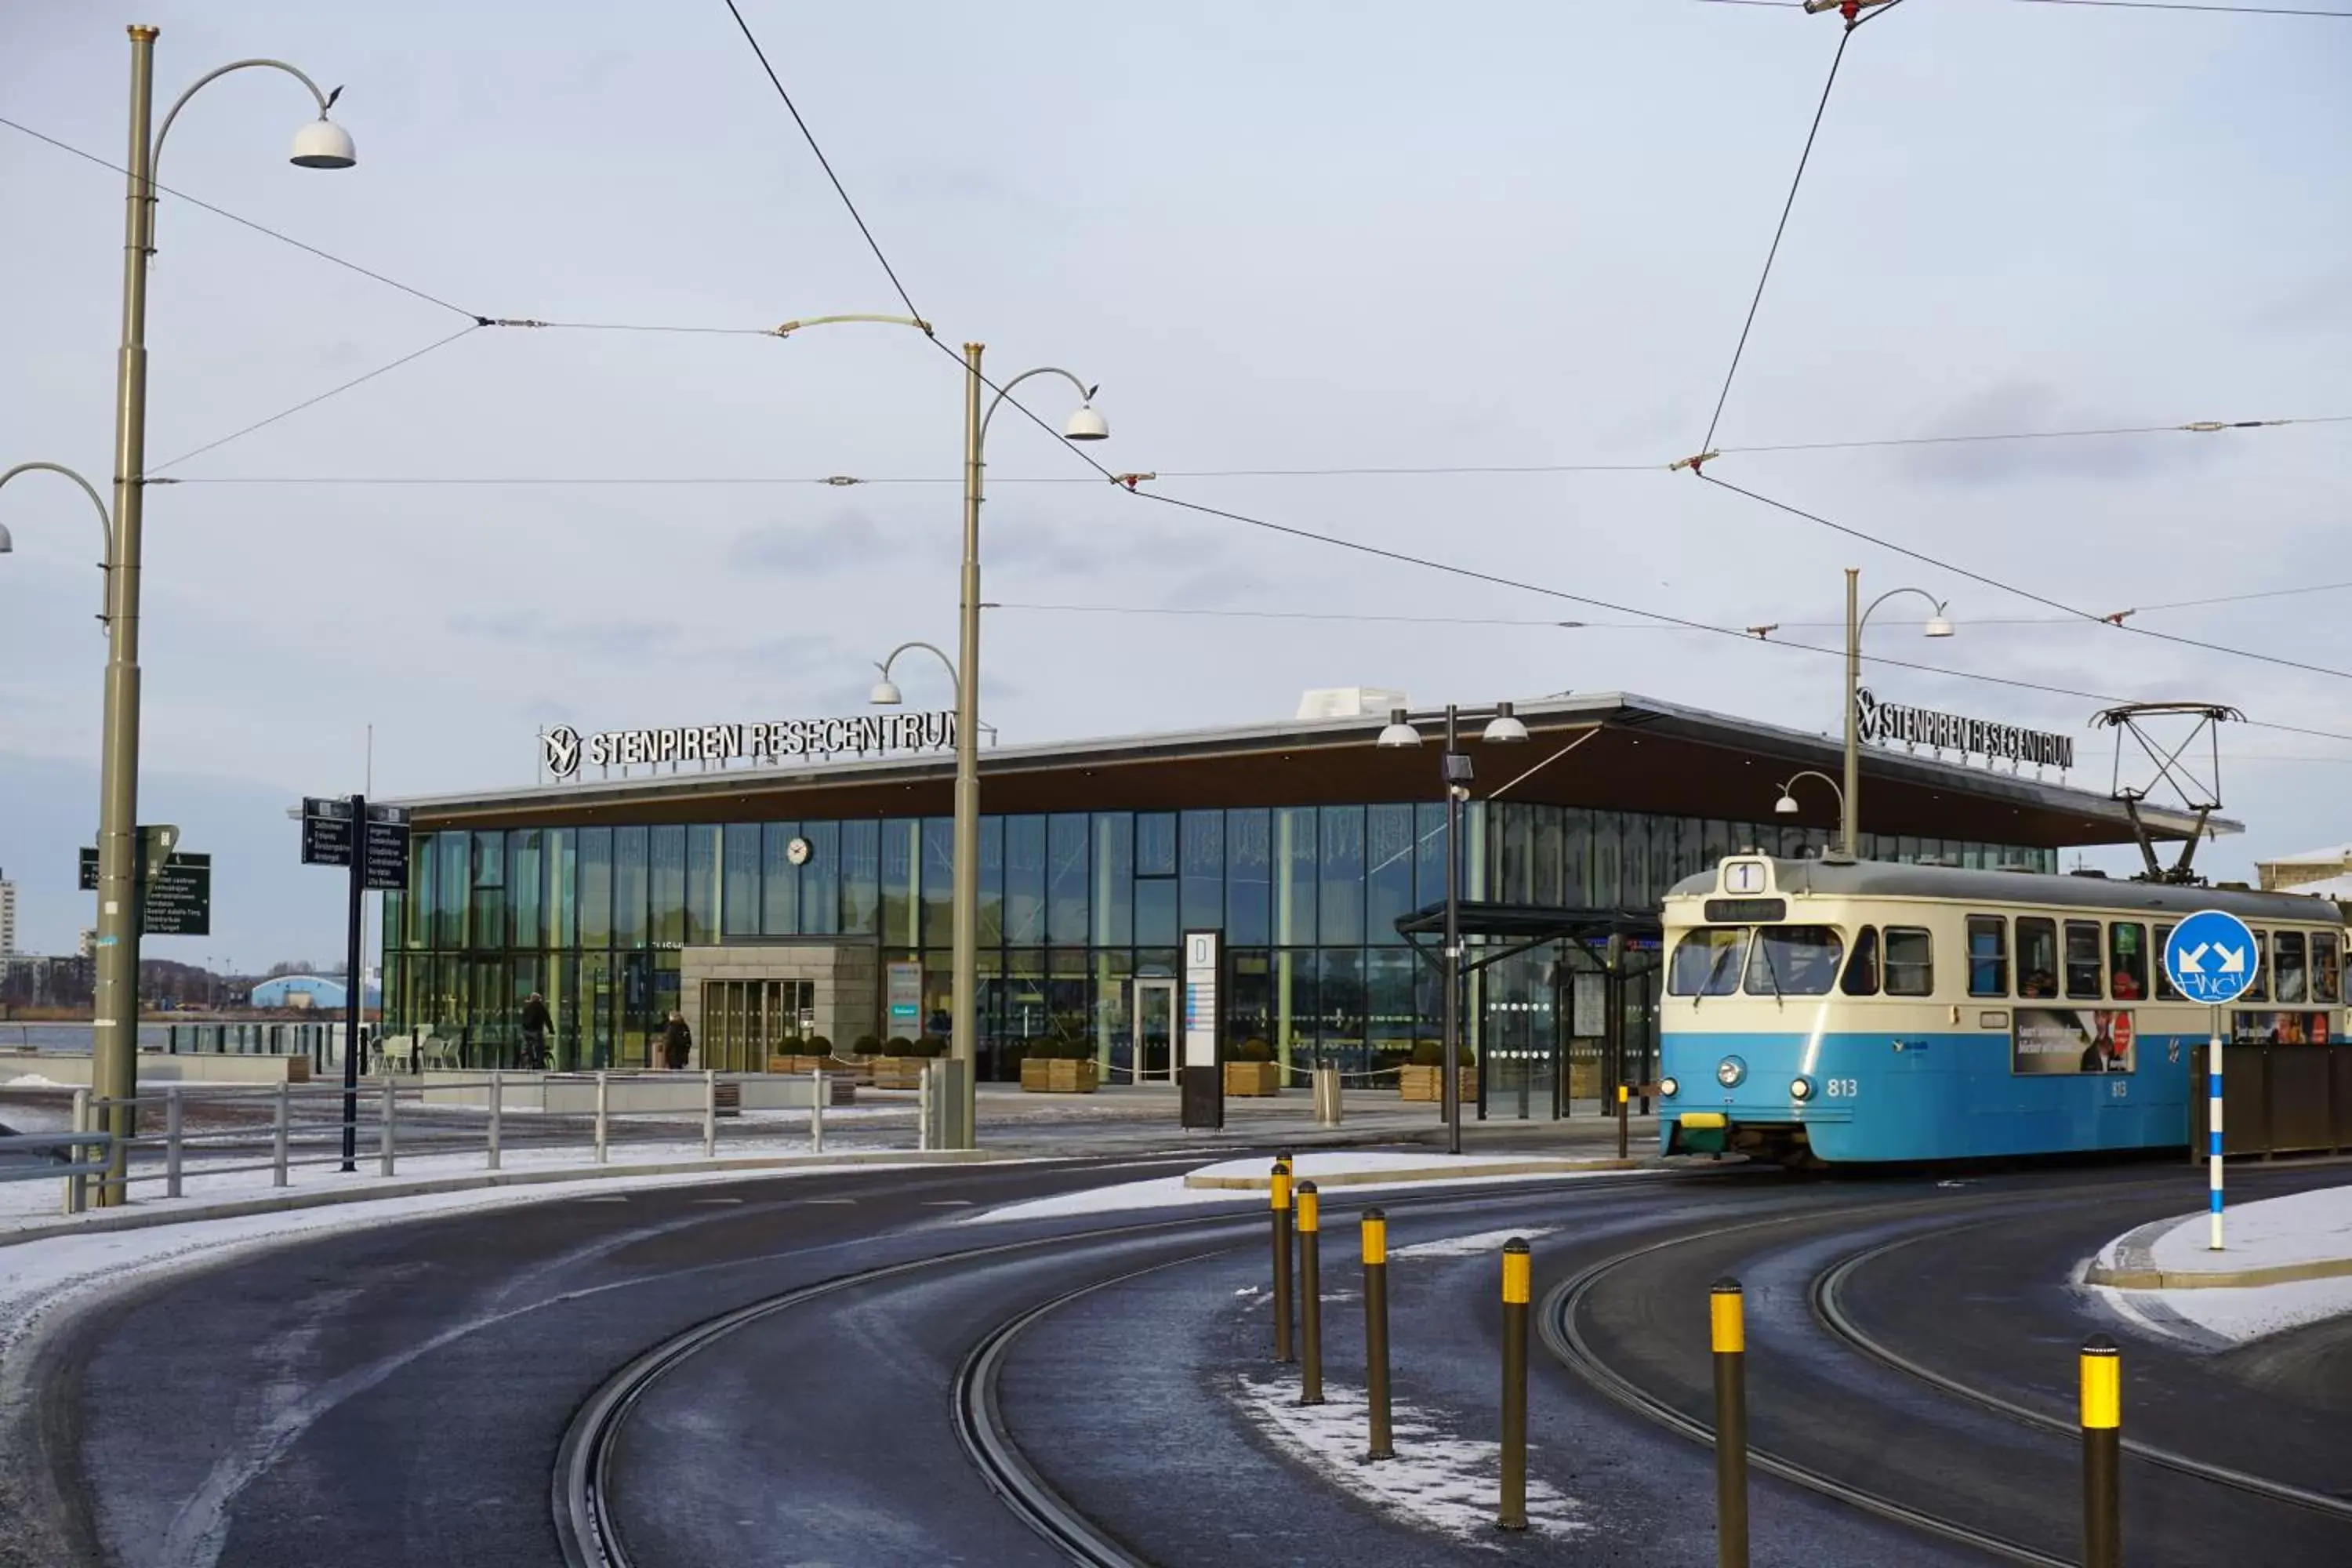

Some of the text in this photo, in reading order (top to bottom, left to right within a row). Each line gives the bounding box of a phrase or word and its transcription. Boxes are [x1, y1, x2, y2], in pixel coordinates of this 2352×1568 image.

[590, 724, 742, 766] STENPIREN
[1882, 703, 2074, 768] STENPIREN RESECENTRUM
[1738, 865, 1748, 889] 1
[1196, 938, 1207, 964] D
[1828, 1078, 1857, 1097] 813
